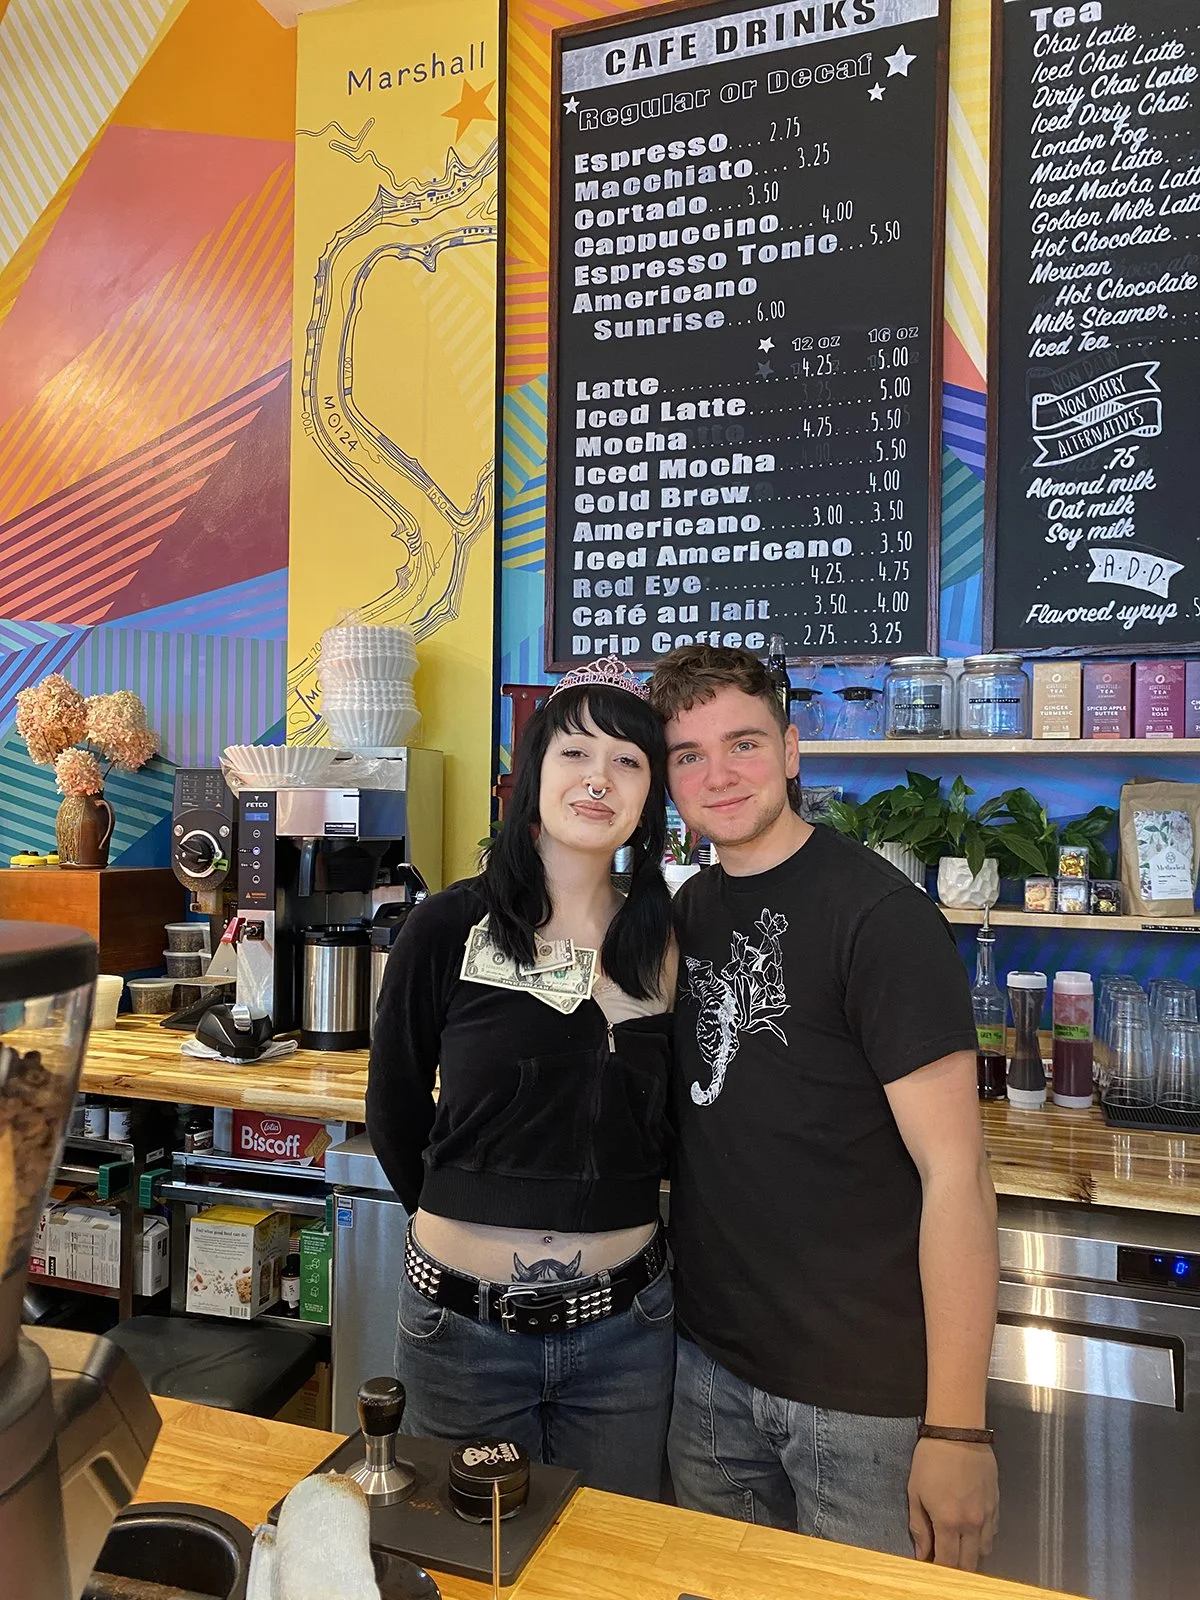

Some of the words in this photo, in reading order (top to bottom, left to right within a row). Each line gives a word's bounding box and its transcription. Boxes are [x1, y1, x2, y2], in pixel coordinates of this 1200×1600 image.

[1030, 1, 1102, 33] Tea
[605, 33, 697, 77] CAFE
[715, 0, 877, 55] DRINKS
[1033, 33, 1081, 58] Chai
[1085, 22, 1137, 49] Latte
[348, 41, 485, 95] Marshall
[1031, 57, 1074, 84] Iced
[1078, 49, 1128, 76] Chai
[1132, 39, 1185, 66] Latte
[578, 87, 711, 131] Regular
[719, 78, 757, 104] or
[767, 52, 873, 95] Decaf
[1032, 84, 1085, 115] Dirty
[1090, 73, 1140, 99] Chai
[1144, 62, 1198, 90] Latte
[1031, 107, 1073, 135] Iced
[1077, 102, 1132, 131] Dirty
[1137, 91, 1189, 116] Chai
[574, 132, 728, 174] Espresso
[769, 116, 801, 143] 2.75
[1031, 133, 1106, 160] London
[1110, 124, 1149, 154] Fog
[574, 157, 753, 202] Macchiato
[797, 142, 830, 169] 3.25
[1030, 159, 1106, 185] Matcha
[1111, 147, 1164, 173] Latte
[574, 195, 708, 231] Cortado
[747, 180, 779, 206] 3.50
[1030, 184, 1073, 209] Iced
[1074, 175, 1153, 203] Matcha
[1159, 166, 1200, 191] Latt
[574, 214, 779, 258] Cappuccino
[820, 200, 854, 225] 4.00
[1032, 210, 1103, 235] Golden
[1106, 197, 1155, 225] Milk
[1159, 192, 1200, 217] Latt
[574, 249, 727, 287] Espresso
[737, 233, 838, 266] Tonic
[870, 220, 901, 245] 5.50
[1031, 237, 1068, 261] Hot
[1071, 223, 1172, 253] Chocolate
[1029, 260, 1112, 285] Mexican
[1055, 284, 1092, 307] Hot
[1096, 272, 1198, 301] Chocolate
[572, 276, 758, 314] Americano
[593, 308, 725, 341] Sunrise
[757, 300, 786, 322] 6.00
[792, 336, 814, 352] 12
[818, 335, 841, 349] oz
[868, 327, 891, 343] 16
[896, 325, 919, 340] oz
[1029, 312, 1075, 336] Milk
[1079, 302, 1168, 330] Steamer
[1029, 335, 1070, 360] Iced
[1080, 328, 1112, 351] Tea
[576, 377, 660, 401] Latte
[802, 354, 833, 377] 4.25
[878, 346, 909, 370] 5.00
[575, 403, 650, 430] Iced
[660, 396, 746, 422] Latte
[880, 376, 911, 400] 5.00
[1056, 392, 1087, 419] NON
[1088, 373, 1127, 404] DAIRY
[575, 430, 688, 458] Mocha
[803, 416, 833, 438] 4.75
[870, 408, 902, 433] 5.50
[575, 460, 649, 486] Iced
[659, 452, 776, 480] Mocha
[876, 438, 907, 461] 5.50
[1103, 445, 1140, 470] .75
[575, 489, 650, 514] Cold
[660, 484, 749, 510] Brew
[869, 469, 901, 492] 4.00
[1025, 474, 1105, 499] Almond
[1106, 468, 1157, 495] milk
[573, 513, 762, 542] Americano
[813, 504, 843, 527] 3.00
[873, 500, 904, 524] 3.50
[1048, 499, 1084, 520] Oat
[1087, 494, 1135, 518] milk
[574, 545, 647, 571] Iced
[656, 536, 853, 567] Americano
[880, 531, 913, 555] 3.50
[1045, 522, 1083, 551] Soy
[1087, 517, 1135, 542] milk
[573, 575, 635, 599] Red
[645, 574, 702, 600] Eye
[811, 562, 843, 585] 4.25
[878, 560, 910, 583] 4.75
[572, 604, 647, 628] Café
[657, 603, 699, 624] au
[710, 598, 771, 622] lait
[814, 594, 845, 615] 3.50
[877, 590, 909, 614] 4.00
[1026, 601, 1116, 624] Flavored
[1116, 602, 1178, 630] syrup
[573, 633, 641, 657] Drip
[651, 630, 765, 654] Coffee
[804, 624, 835, 645] 2.75
[869, 621, 902, 645] 3.25
[241, 1125, 300, 1158] Biscoff
